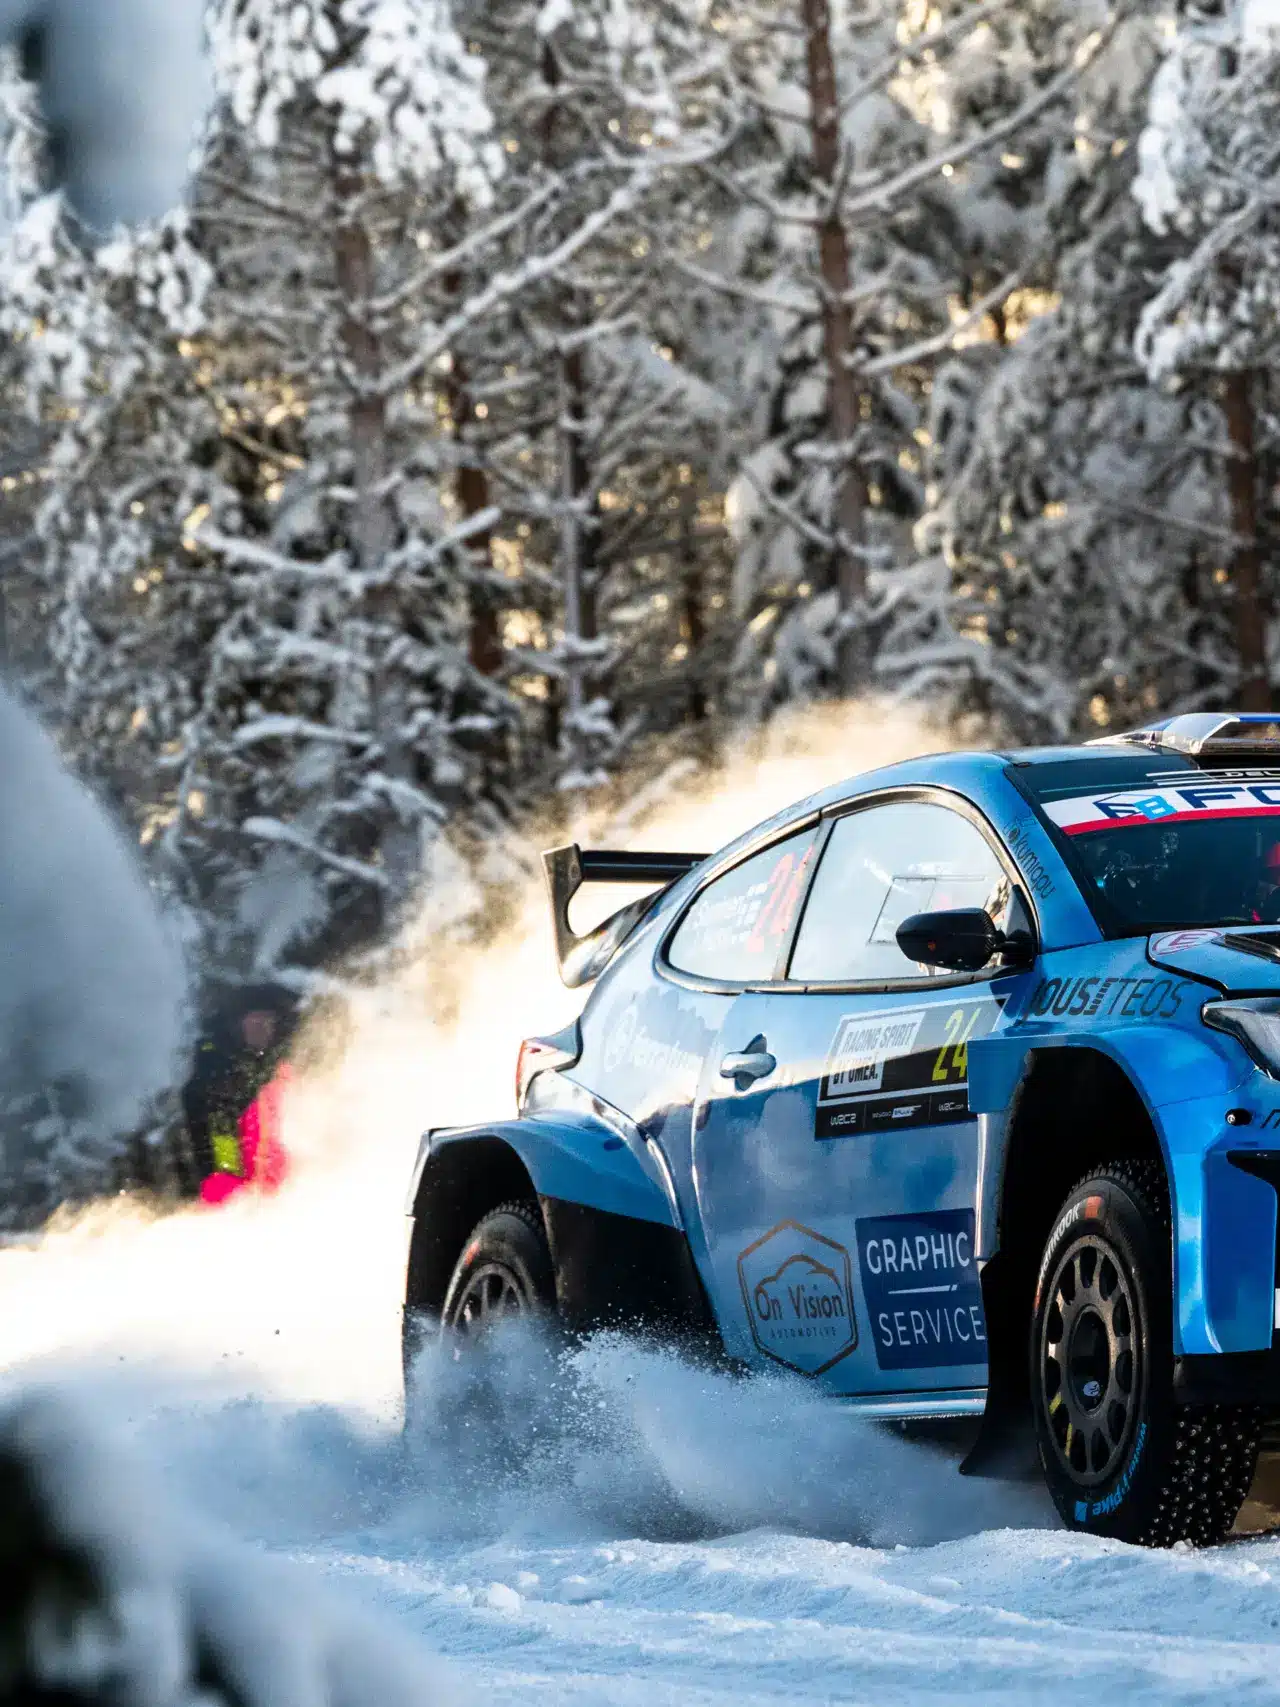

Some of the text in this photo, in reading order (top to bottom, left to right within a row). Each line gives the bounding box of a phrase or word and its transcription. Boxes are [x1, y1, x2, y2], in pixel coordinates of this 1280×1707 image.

[841, 1021, 919, 1054] RACING SPIRIT
[931, 1007, 982, 1082] 24
[865, 1230, 971, 1275] GRAPHIC
[877, 1304, 987, 1347] SERVICE
